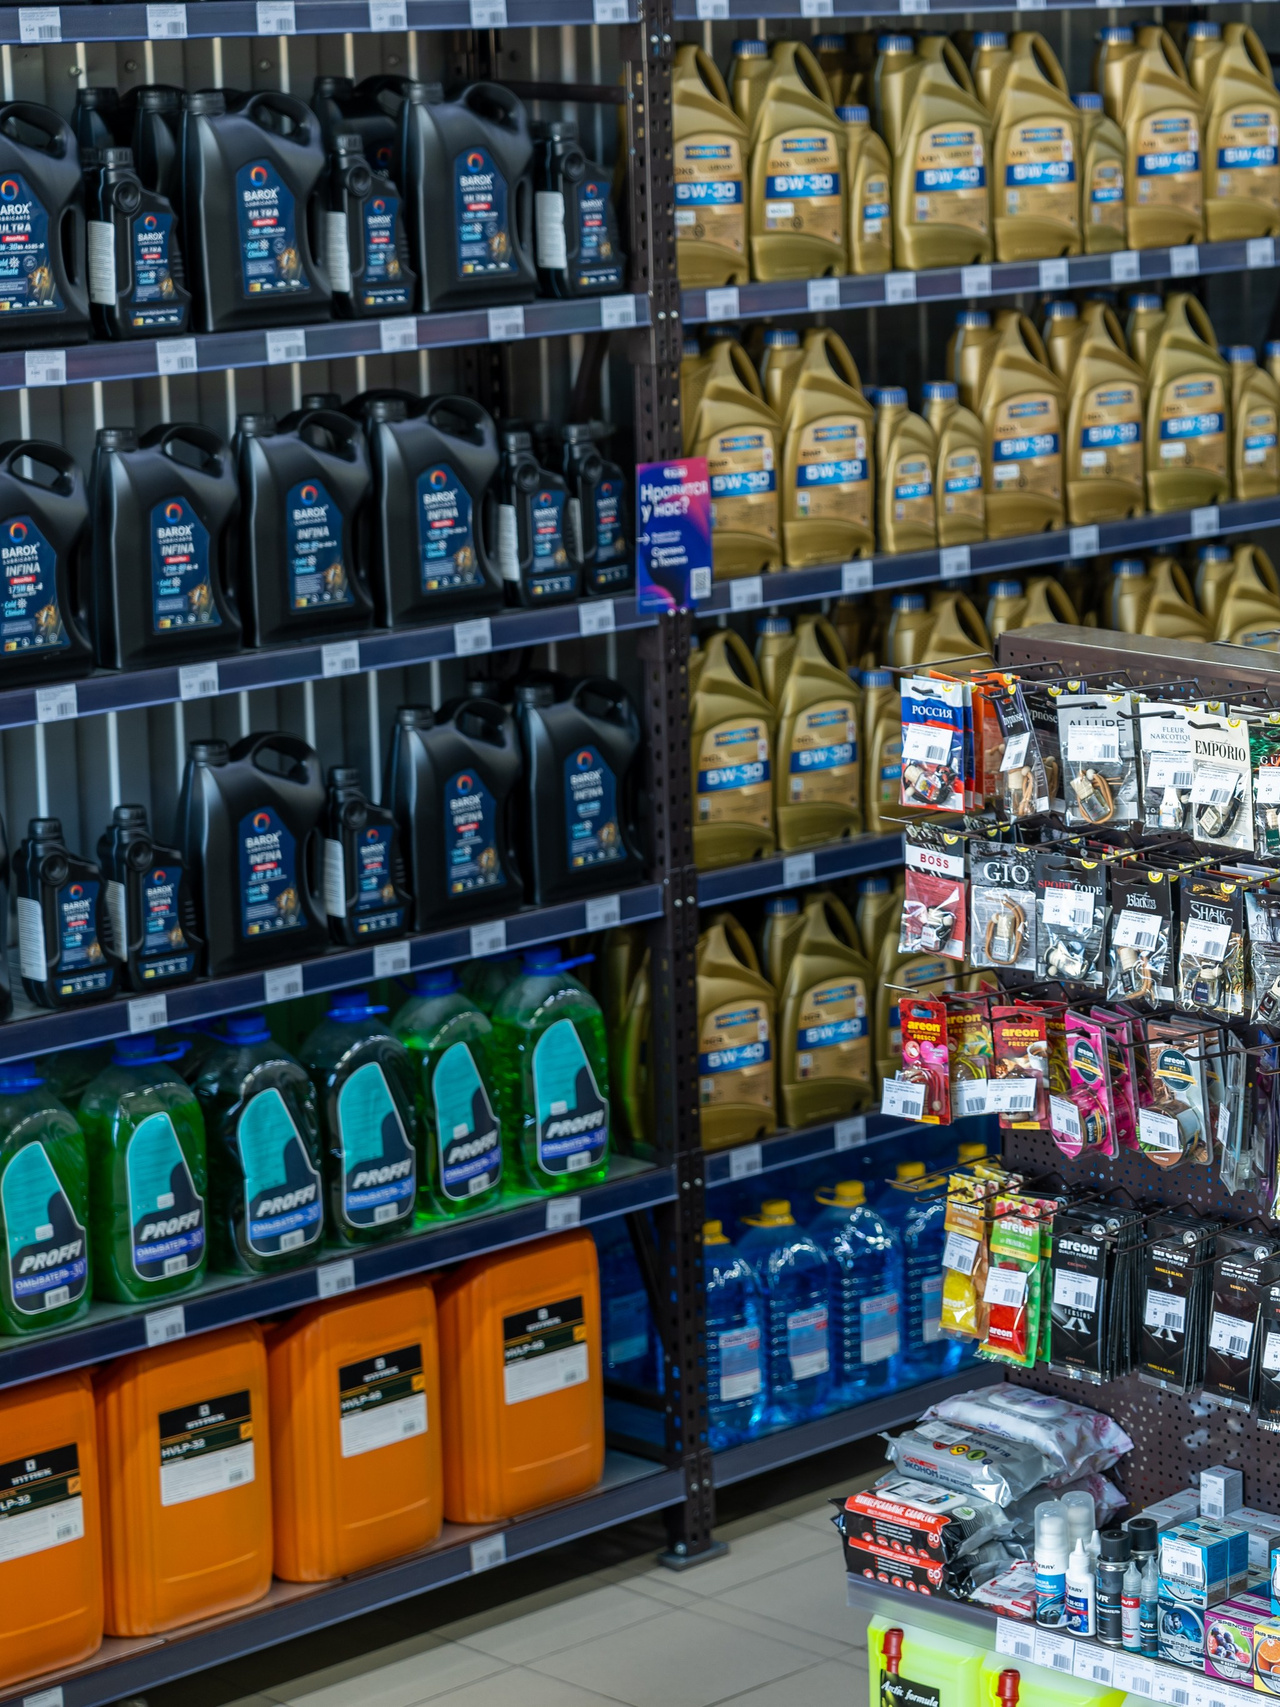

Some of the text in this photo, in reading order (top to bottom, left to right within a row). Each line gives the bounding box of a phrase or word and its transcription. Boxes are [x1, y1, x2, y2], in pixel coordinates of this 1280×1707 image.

[460, 174, 493, 187] BAROX
[774, 175, 833, 192] 5W-30
[923, 168, 980, 186] 5W-40
[243, 188, 278, 202] BAROX
[676, 181, 736, 199] 5W-30
[138, 232, 164, 242] BAROX
[806, 460, 862, 480] 5W-30
[712, 472, 770, 492] 5W-30
[422, 492, 457, 505] BAROX
[293, 507, 327, 520] BAROX
[157, 525, 192, 538] BAROX
[296, 526, 330, 540] INFINA
[1, 543, 37, 560] BAROX
[160, 543, 195, 556] INFINA
[5, 562, 41, 578] INFINA
[912, 704, 952, 719] РОССИЯ
[1150, 734, 1190, 742] NARCOTIQ
[799, 745, 853, 767] 5W-30
[1195, 740, 1246, 761] EMPORIO
[706, 763, 763, 787] 5W-30
[450, 797, 481, 810] BAROX
[246, 835, 280, 847] BAROX
[249, 850, 282, 864] INFINA
[920, 853, 950, 869] BOSS
[983, 861, 1029, 884] GIO
[147, 886, 174, 897] BAROX
[1038, 880, 1102, 895] SPORT CODE
[63, 900, 91, 911] BAROX
[907, 1021, 941, 1032] areon
[1001, 1028, 1040, 1038] areon
[913, 1034, 936, 1042] FRESCO
[707, 1044, 765, 1067] 5W-40
[1164, 1056, 1186, 1065] areon
[546, 1109, 604, 1139] PROFFI
[448, 1130, 498, 1164] PROFFI
[353, 1159, 412, 1188] PROFFI
[256, 1185, 315, 1218] PROFFI
[140, 1209, 200, 1242] PROFFI
[1000, 1221, 1033, 1236] areon
[1058, 1238, 1099, 1255] areon
[19, 1239, 82, 1274] PROFFI
[989, 1327, 1013, 1338] areon
[161, 1439, 206, 1458] HVLP-32
[903, 1460, 939, 1478] ЭКОНОМ
[928, 1533, 940, 1543] 60
[928, 1568, 941, 1580] 60
[1215, 1619, 1253, 1632] SPENCER
[881, 1678, 939, 1707] Arctic formula
